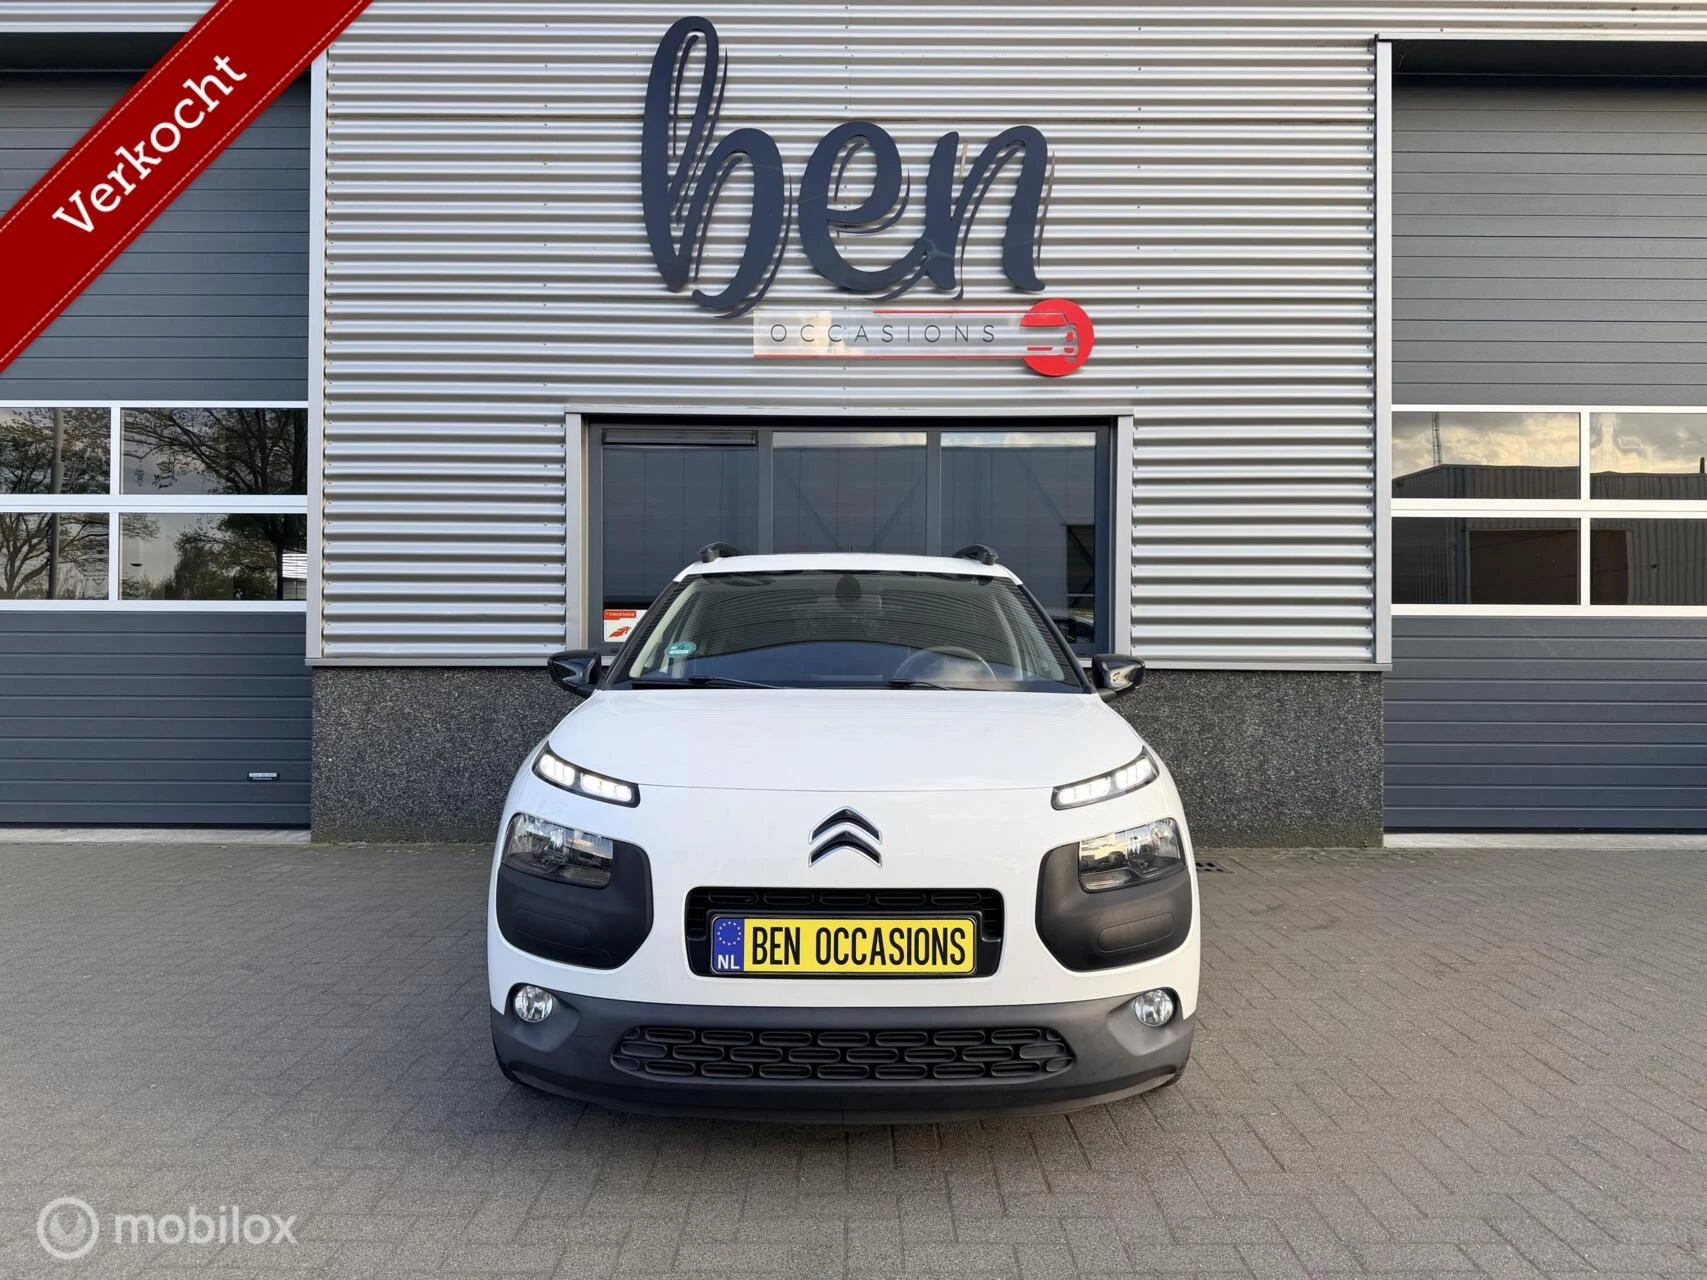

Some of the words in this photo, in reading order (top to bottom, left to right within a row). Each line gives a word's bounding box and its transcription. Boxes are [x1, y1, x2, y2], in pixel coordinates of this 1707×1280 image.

[641, 15, 1048, 309] ben
[769, 323, 995, 343] OCCASIONS
[752, 926, 801, 965] BEN
[816, 927, 966, 965] OCCASIONS
[717, 954, 740, 969] NL
